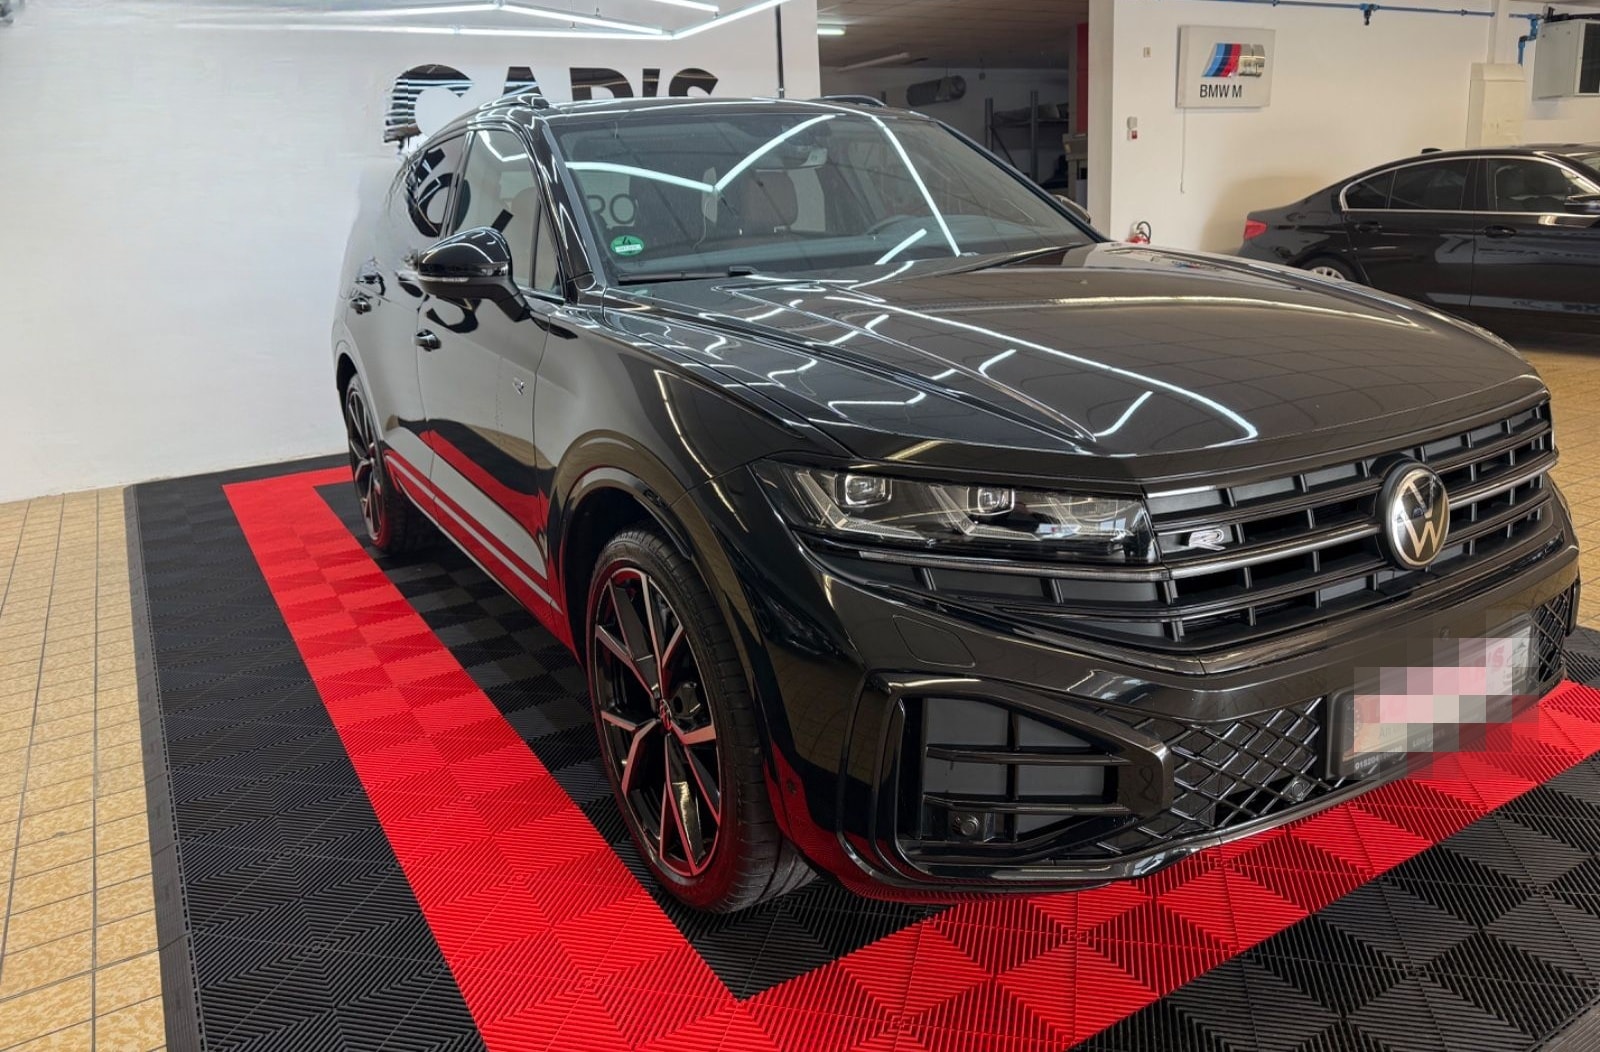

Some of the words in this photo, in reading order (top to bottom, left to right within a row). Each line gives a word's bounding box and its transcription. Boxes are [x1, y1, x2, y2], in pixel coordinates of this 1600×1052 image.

[1200, 84, 1229, 98] BMW
[1232, 84, 1242, 98] M
[1189, 528, 1226, 550] R
